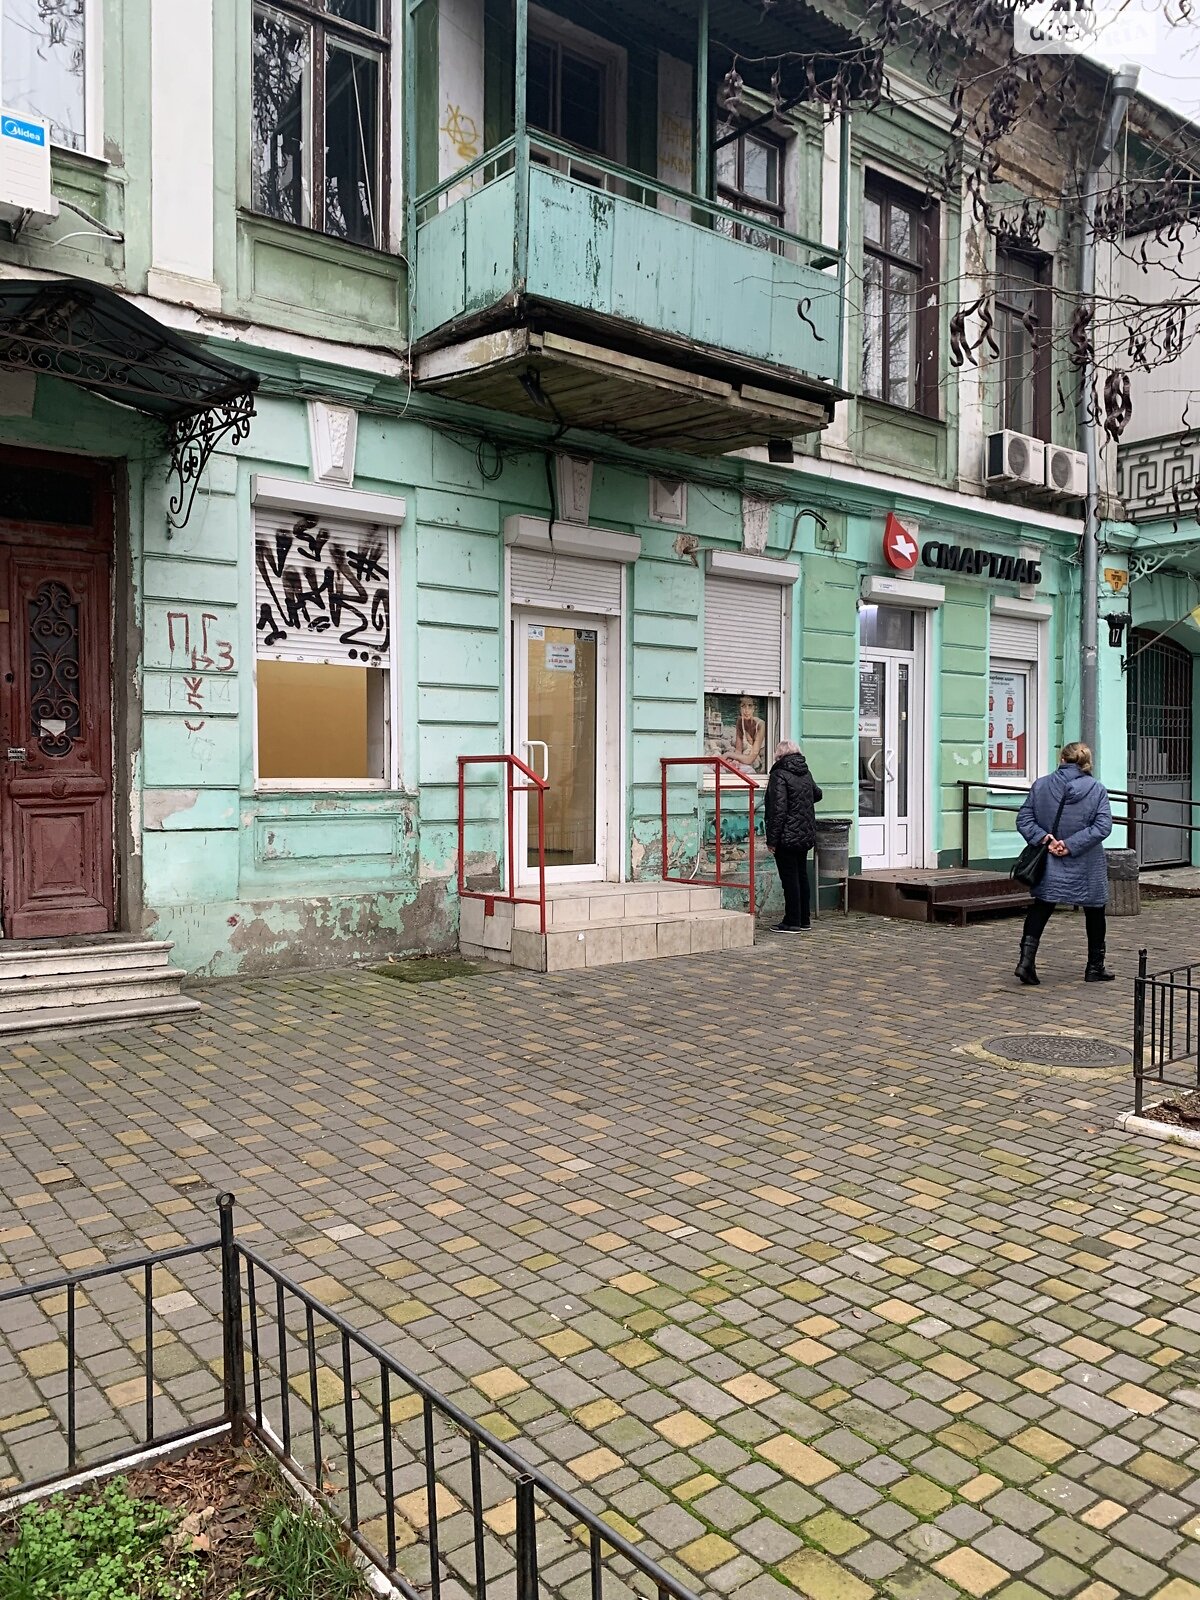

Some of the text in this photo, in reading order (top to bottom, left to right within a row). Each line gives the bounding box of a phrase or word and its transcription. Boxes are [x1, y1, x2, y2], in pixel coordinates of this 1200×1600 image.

[5, 121, 41, 141] Midea
[922, 541, 1042, 584] СМАРТЛАБ
[1112, 628, 1120, 643] 17
